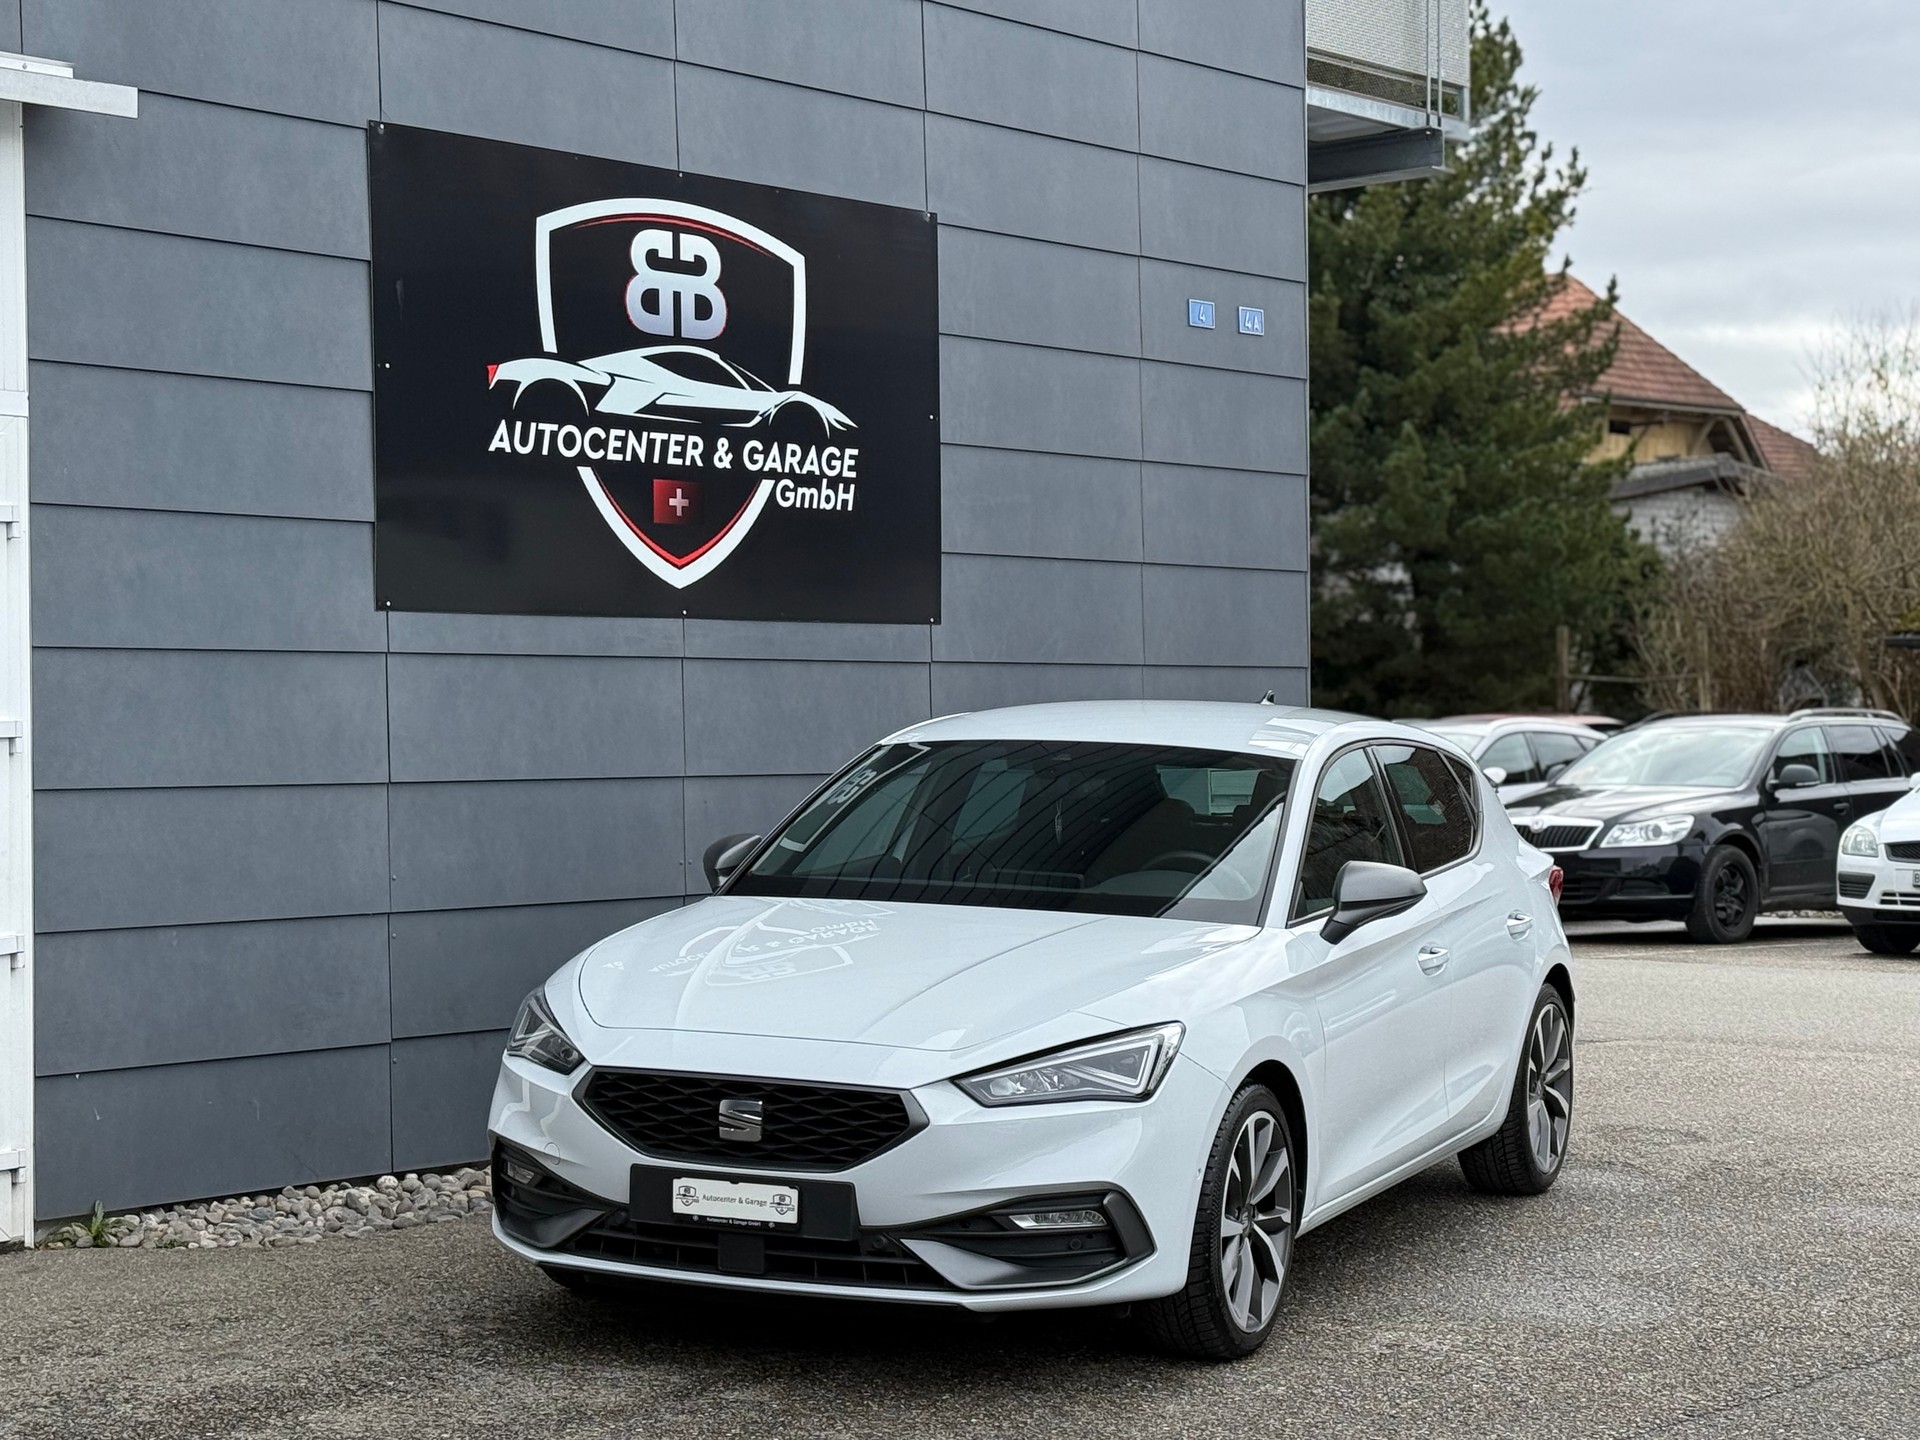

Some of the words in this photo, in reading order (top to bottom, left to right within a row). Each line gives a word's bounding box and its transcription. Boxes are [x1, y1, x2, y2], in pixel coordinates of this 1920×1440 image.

[1199, 305, 1206, 323] 4
[1244, 311, 1259, 331] 4A
[488, 419, 704, 467] AUTOCENTER
[713, 437, 734, 469] &
[742, 439, 859, 478] GARAGE
[775, 478, 855, 511] GmbH
[702, 1194, 737, 1203] Autocenter
[738, 1196, 744, 1204] &
[745, 1197, 768, 1207] Garage
